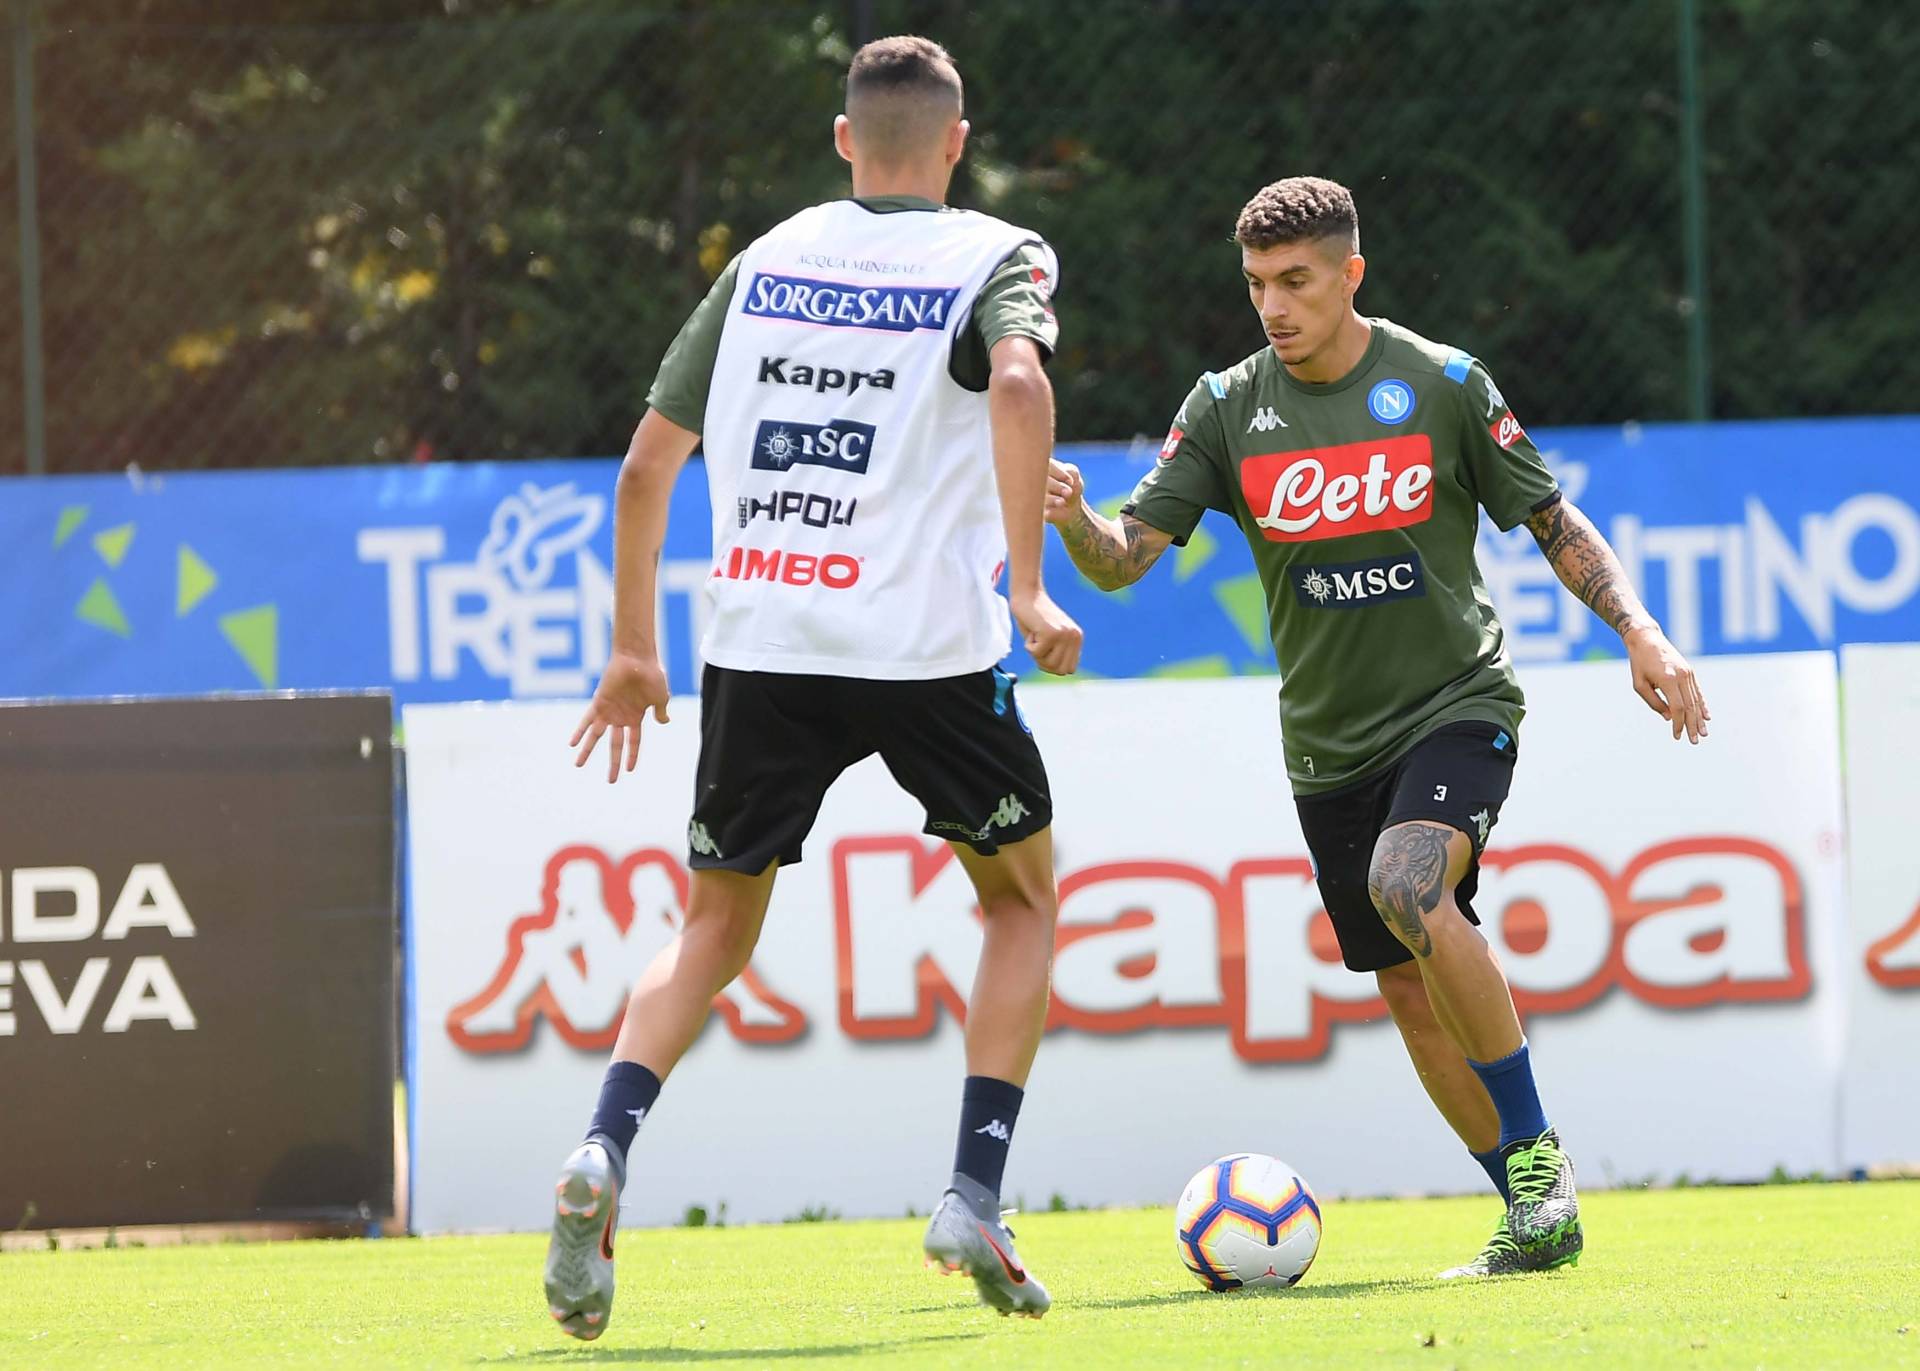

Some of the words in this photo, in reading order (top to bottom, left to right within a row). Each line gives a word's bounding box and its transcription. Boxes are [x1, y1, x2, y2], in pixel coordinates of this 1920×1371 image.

[796, 254, 846, 269] ACQUA
[748, 276, 944, 325] SORGESANA
[1381, 390, 1402, 412] N
[1256, 453, 1432, 534] Lete
[712, 547, 862, 589] IMBO
[1331, 562, 1415, 601] MSC
[1433, 785, 1448, 802] 3
[0, 863, 196, 943] DA
[0, 956, 198, 1036] VA
